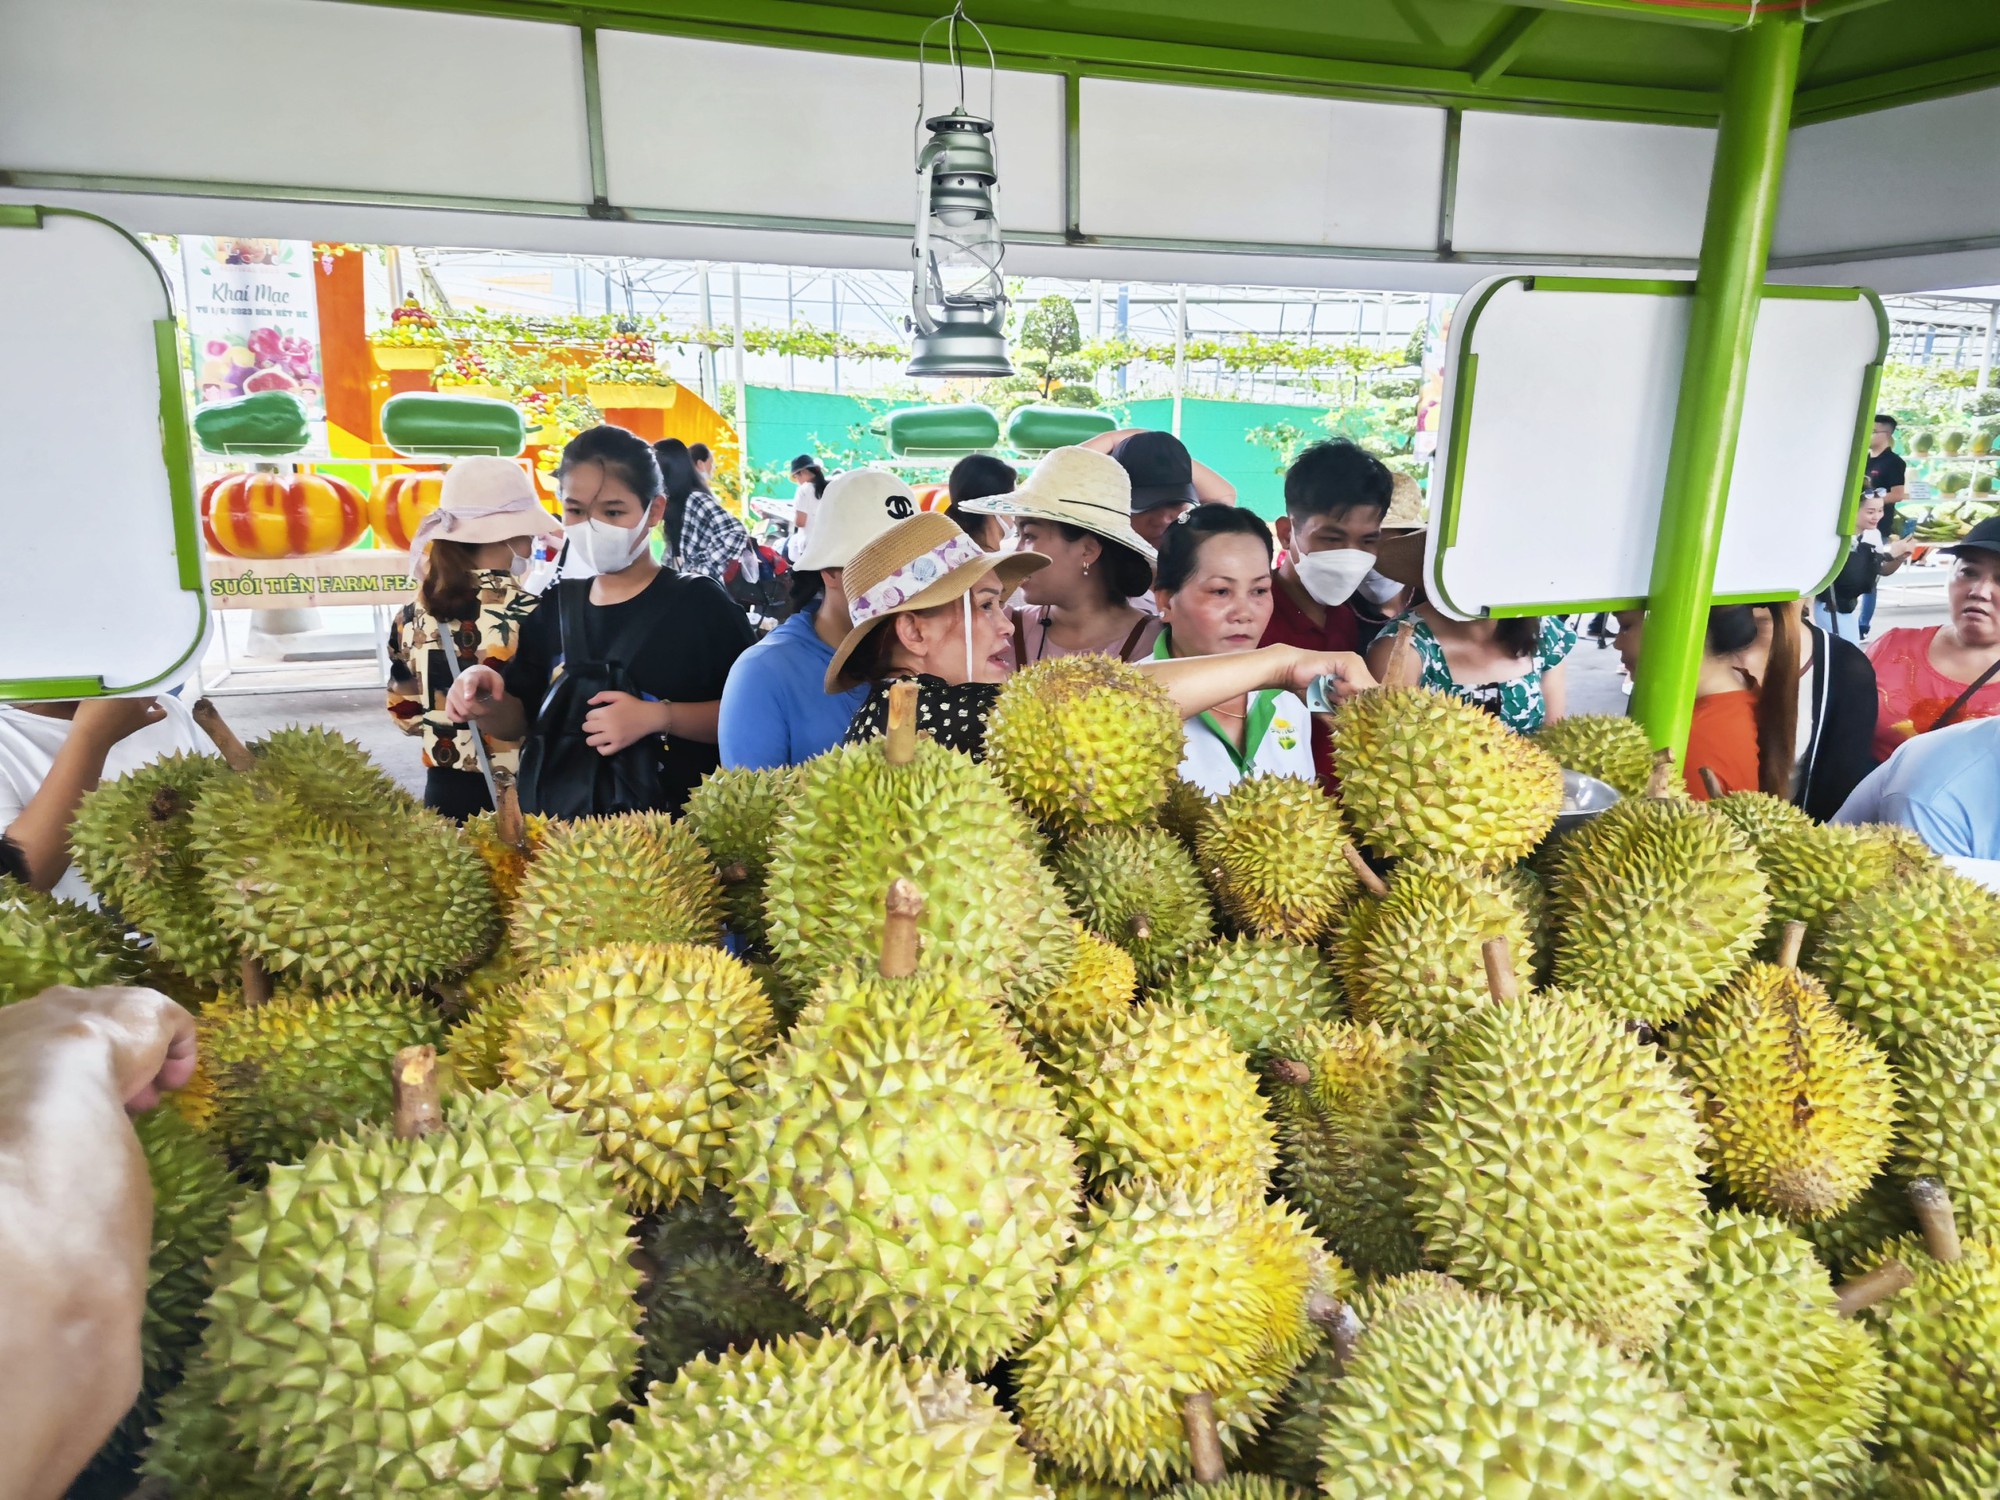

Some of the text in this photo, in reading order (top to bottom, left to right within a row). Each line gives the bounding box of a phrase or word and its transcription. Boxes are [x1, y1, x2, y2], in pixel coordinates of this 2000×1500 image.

[255, 284, 290, 306] Mạc
[210, 570, 262, 596] SUỐI
[264, 573, 315, 594] TIÊN
[318, 575, 379, 593] FARM
